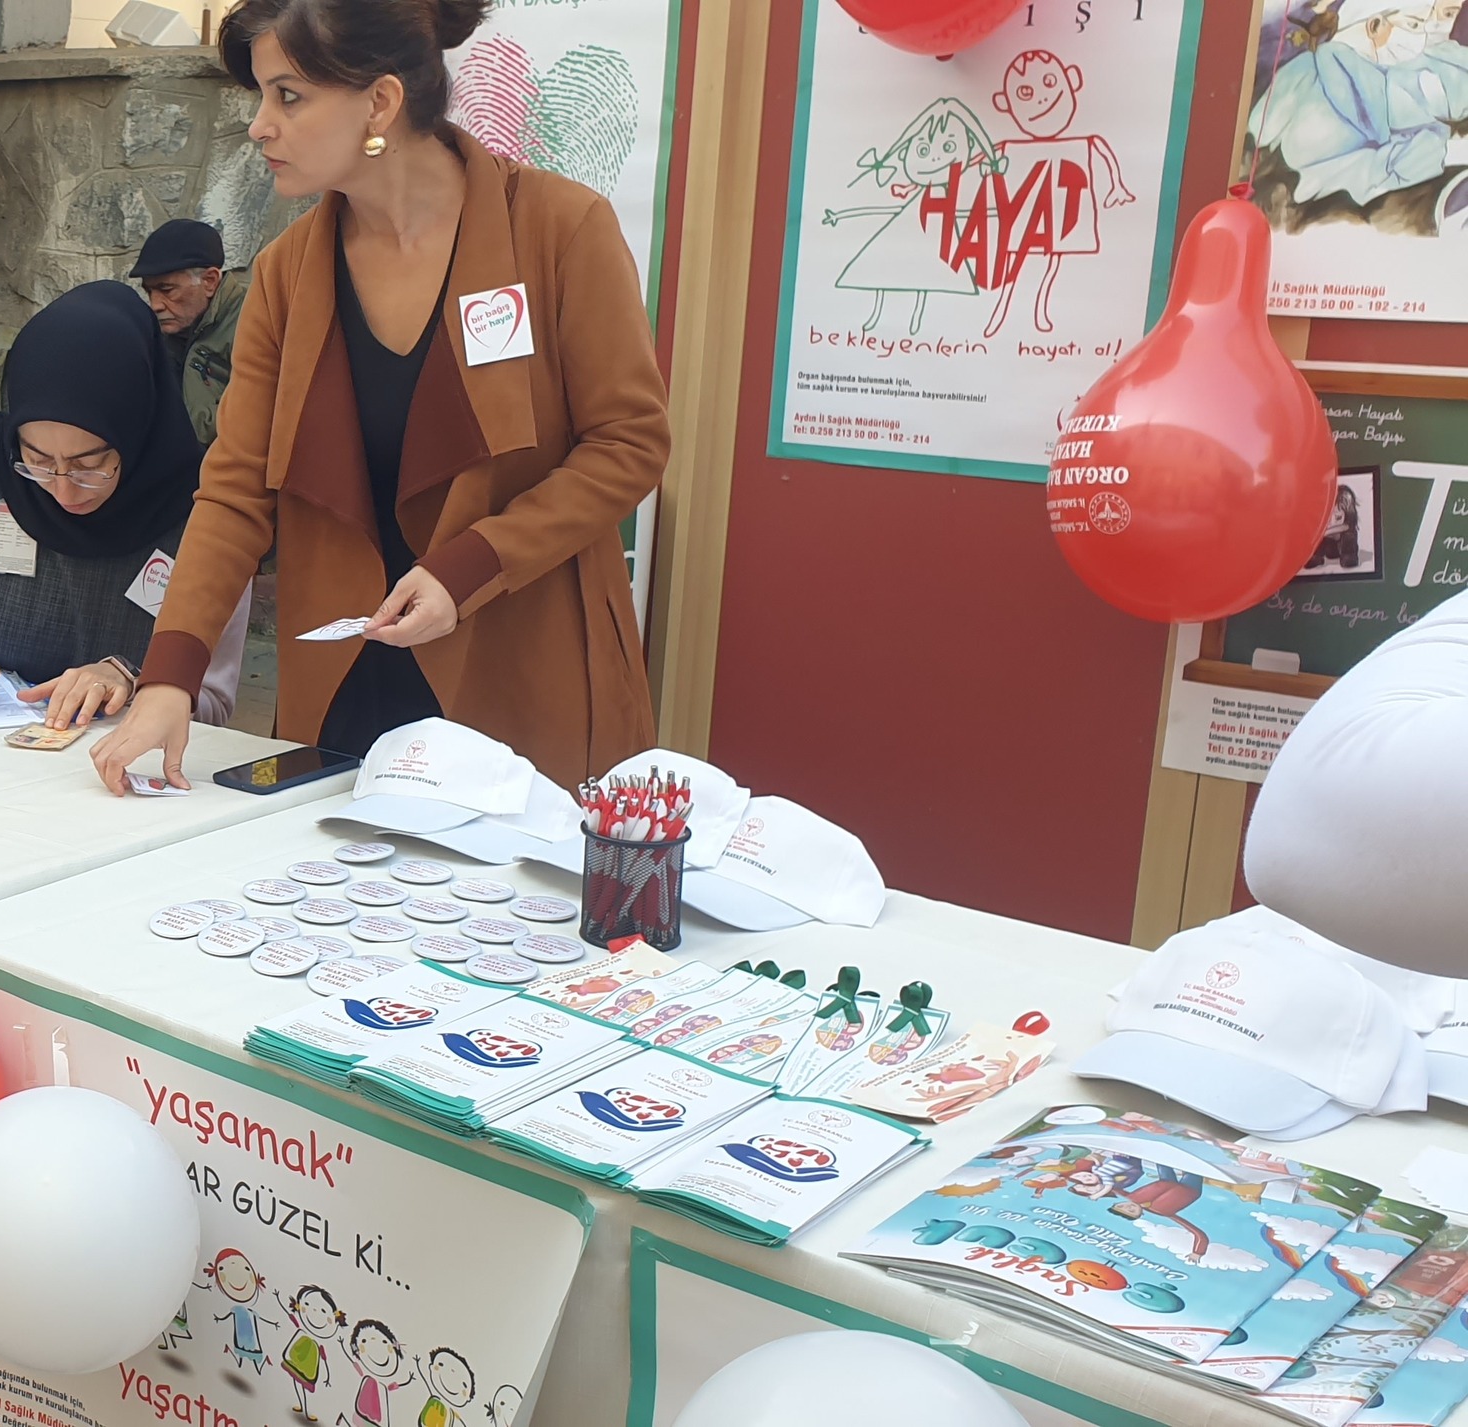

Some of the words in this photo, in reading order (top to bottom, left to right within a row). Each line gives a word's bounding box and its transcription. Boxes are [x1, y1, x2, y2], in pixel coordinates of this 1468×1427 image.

[919, 158, 1089, 291] HAYAT
[1283, 283, 1319, 295] Sağlık
[1323, 285, 1386, 298] Müdürlüğü
[471, 314, 483, 324] bir
[485, 303, 510, 318] bağış
[1294, 298, 1317, 309] 213
[1321, 300, 1335, 310] 50
[1339, 300, 1354, 311] 00
[1368, 301, 1389, 312] 192
[1403, 302, 1426, 313] 214
[475, 324, 488, 334] bir
[489, 311, 514, 328] hayat
[809, 325, 988, 358] bekleyenlerin
[1018, 340, 1082, 361] hayatı
[1094, 338, 1122, 363] ol!
[797, 382, 811, 391] tüm
[812, 384, 834, 393] sağlık
[836, 385, 858, 394] kurum
[798, 371, 819, 381] Organ
[858, 375, 894, 385] bulunmak
[794, 413, 817, 424] Aydın
[827, 415, 852, 427] Sağlık
[855, 417, 901, 430] Müdürlüğü
[793, 425, 808, 435] Tel:
[836, 428, 852, 438] 213
[854, 429, 865, 439] 50
[867, 430, 879, 440] 00
[888, 432, 904, 443] 192
[913, 434, 931, 444] 214
[1064, 466, 1130, 485] ORGAN
[147, 576, 157, 584] bir
[150, 568, 160, 576] bir
[1302, 595, 1323, 613] de
[1330, 605, 1389, 628] organ
[1210, 720, 1236, 733] Aydın
[1248, 726, 1278, 739] Sağlık
[1207, 742, 1225, 754] Tel:
[1191, 1008, 1217, 1021] HAYAT
[1216, 1017, 1265, 1042] KURTARIR!
[126, 1056, 353, 1188] "yaşamak"
[186, 1161, 222, 1203] AR
[233, 1180, 342, 1257] GÜZEL
[964, 1244, 1090, 1296] Sağlık
[8, 1383, 33, 1400] kurum
[35, 1394, 44, 1404] ve
[32, 1379, 68, 1402] bulunmak
[70, 1395, 86, 1411] için,
[119, 1362, 239, 1427] yaşatm
[4, 1400, 35, 1420] Sağlık
